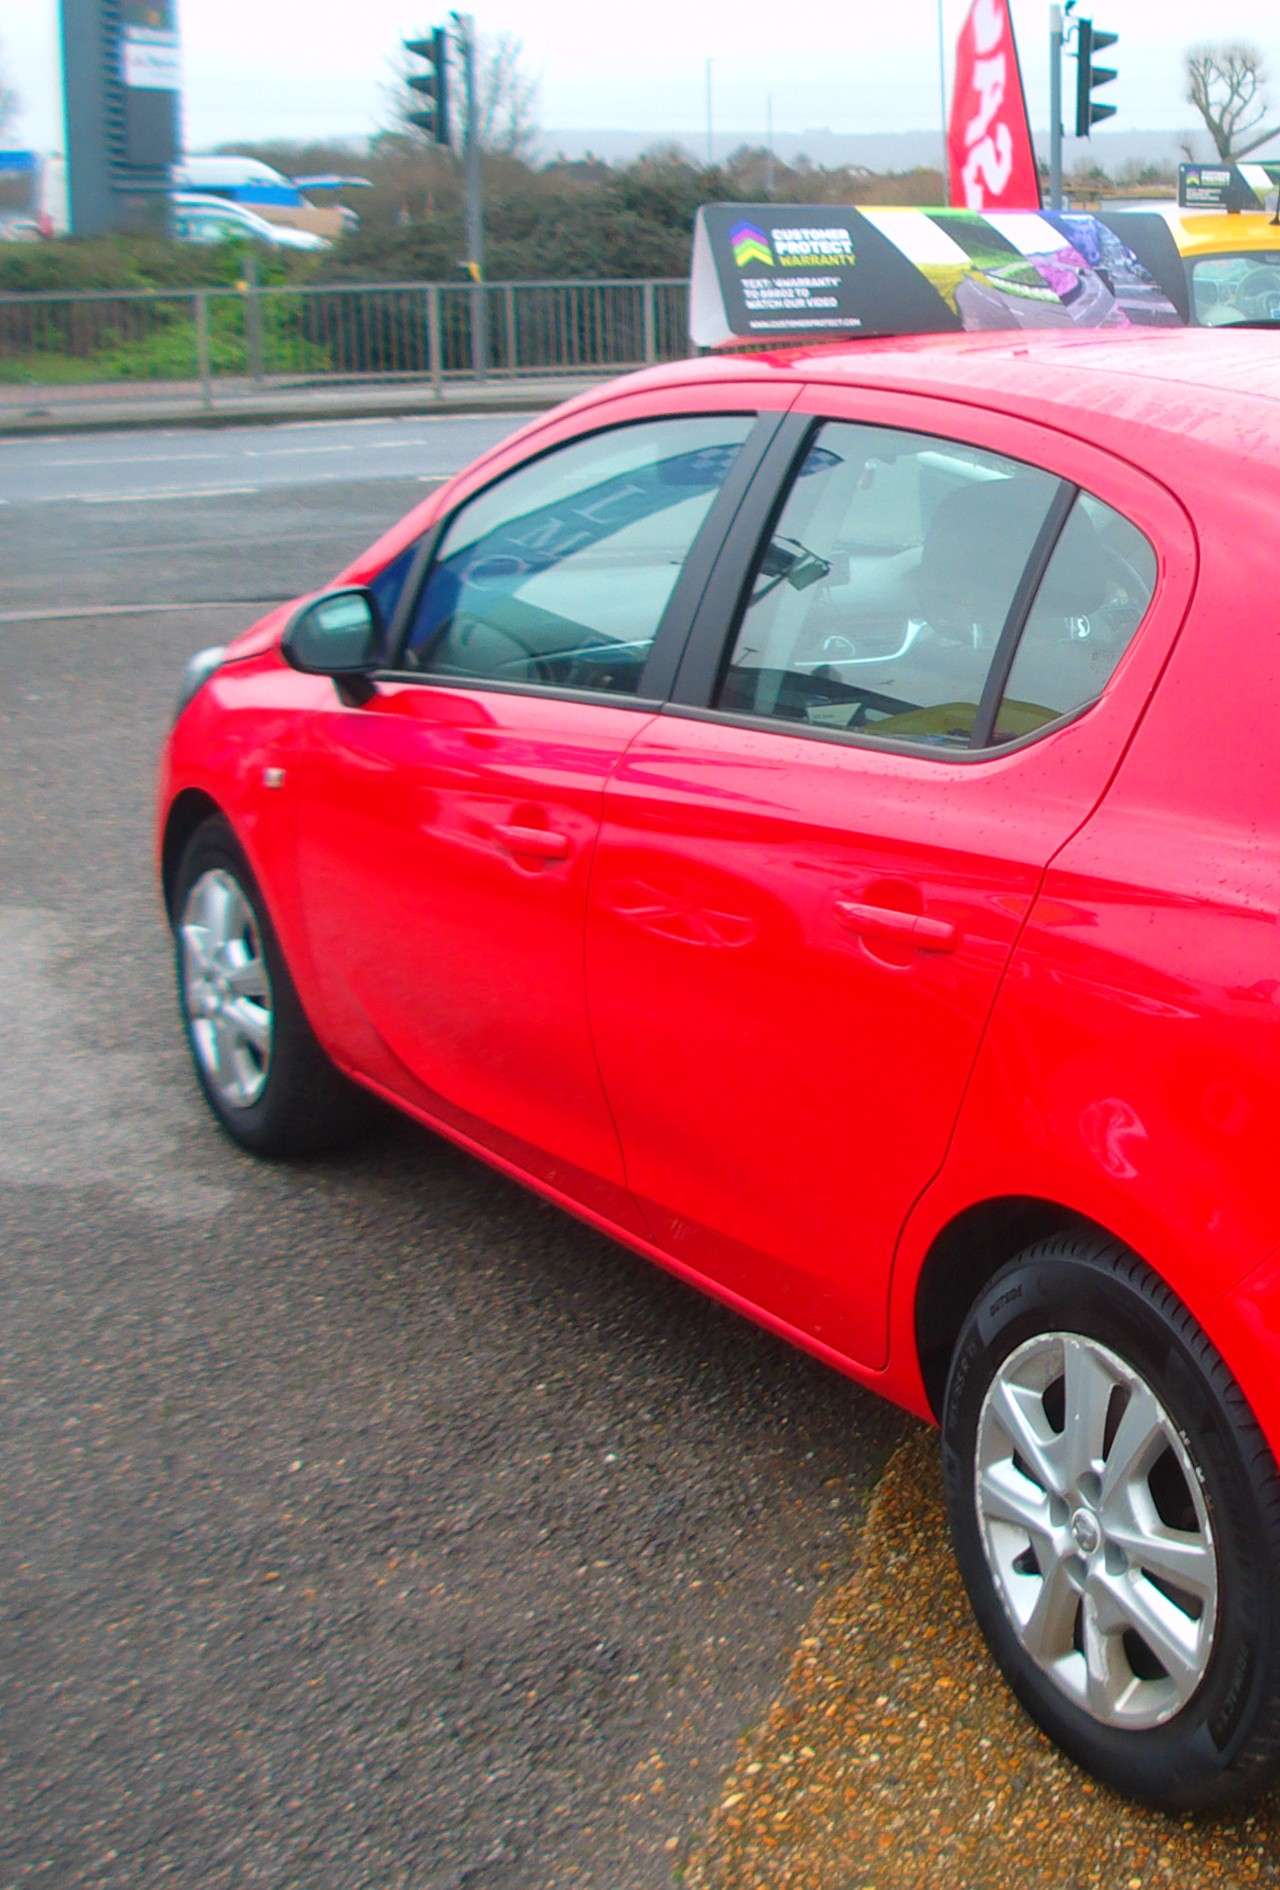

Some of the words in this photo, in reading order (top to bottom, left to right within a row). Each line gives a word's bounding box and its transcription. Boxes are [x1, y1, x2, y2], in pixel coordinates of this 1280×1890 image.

[771, 228, 850, 241] CUSTOMER
[774, 240, 853, 255] PROTECT
[780, 254, 856, 267] WARRANTY
